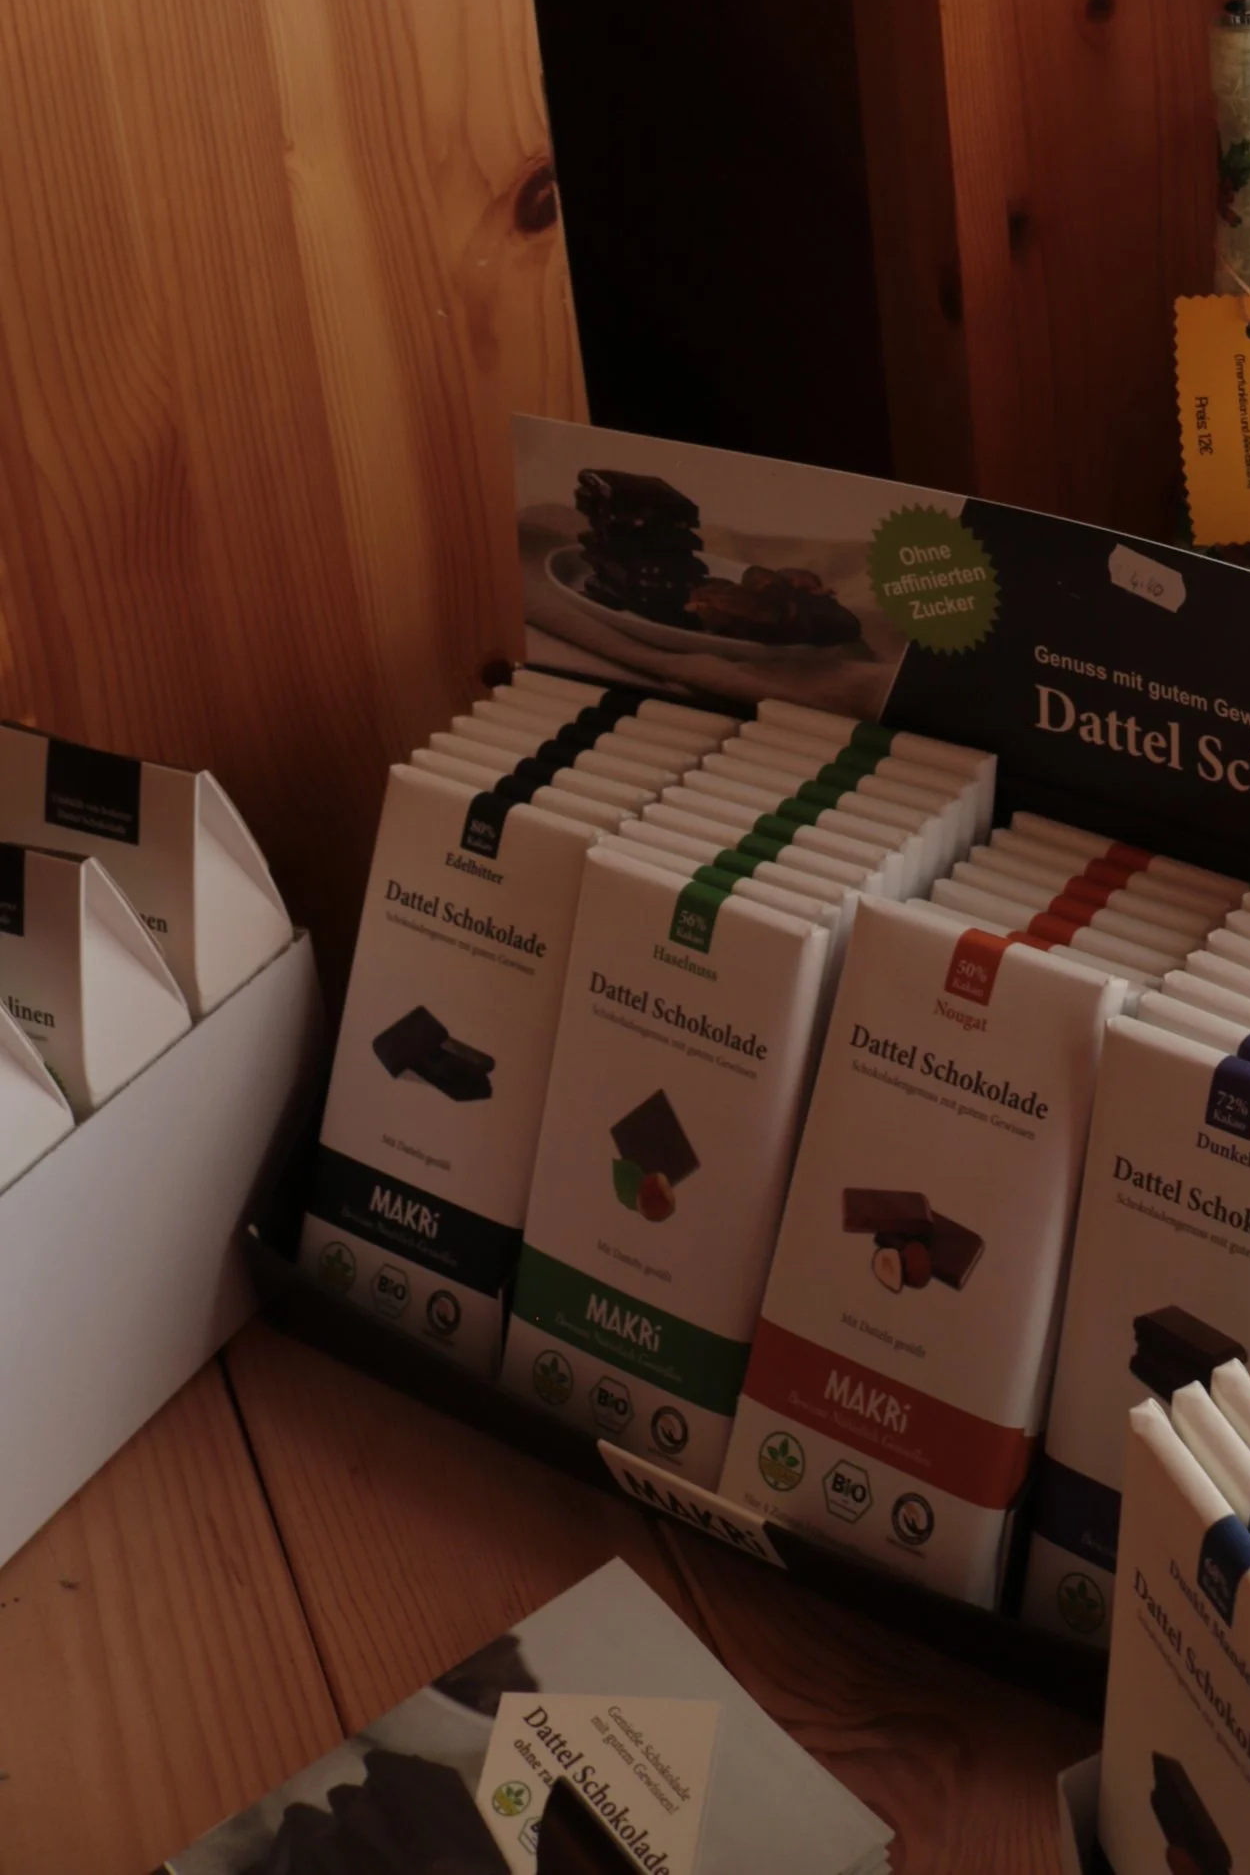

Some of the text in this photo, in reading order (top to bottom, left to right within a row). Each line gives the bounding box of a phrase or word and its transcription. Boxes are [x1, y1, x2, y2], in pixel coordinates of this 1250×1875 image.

[1197, 434, 1213, 456] 12€
[899, 544, 951, 566] Ohne
[883, 566, 987, 598] raffinierten
[908, 595, 976, 620] Zucker
[1033, 644, 1108, 681] Genuss
[1112, 669, 1145, 692] mit
[1147, 680, 1209, 712] gutem
[1033, 682, 1185, 772] Dattel
[444, 851, 505, 885] Edelbitter
[384, 879, 441, 918] Dattel
[441, 901, 549, 958] Schokolade
[652, 943, 719, 982] Haselnuss
[955, 959, 988, 984] 50%
[3, 995, 56, 1028] linen
[588, 970, 769, 1060] Dattel Schokolade
[932, 996, 989, 1032] Nougat
[848, 1022, 1050, 1121] Dattel Schokolade
[1216, 1090, 1250, 1118] 72%
[1112, 1154, 1183, 1207] Dattel
[1134, 1566, 1183, 1658] Dattel
[513, 1738, 542, 1770] ohne
[522, 1704, 671, 1875] Dattel Schokolade
